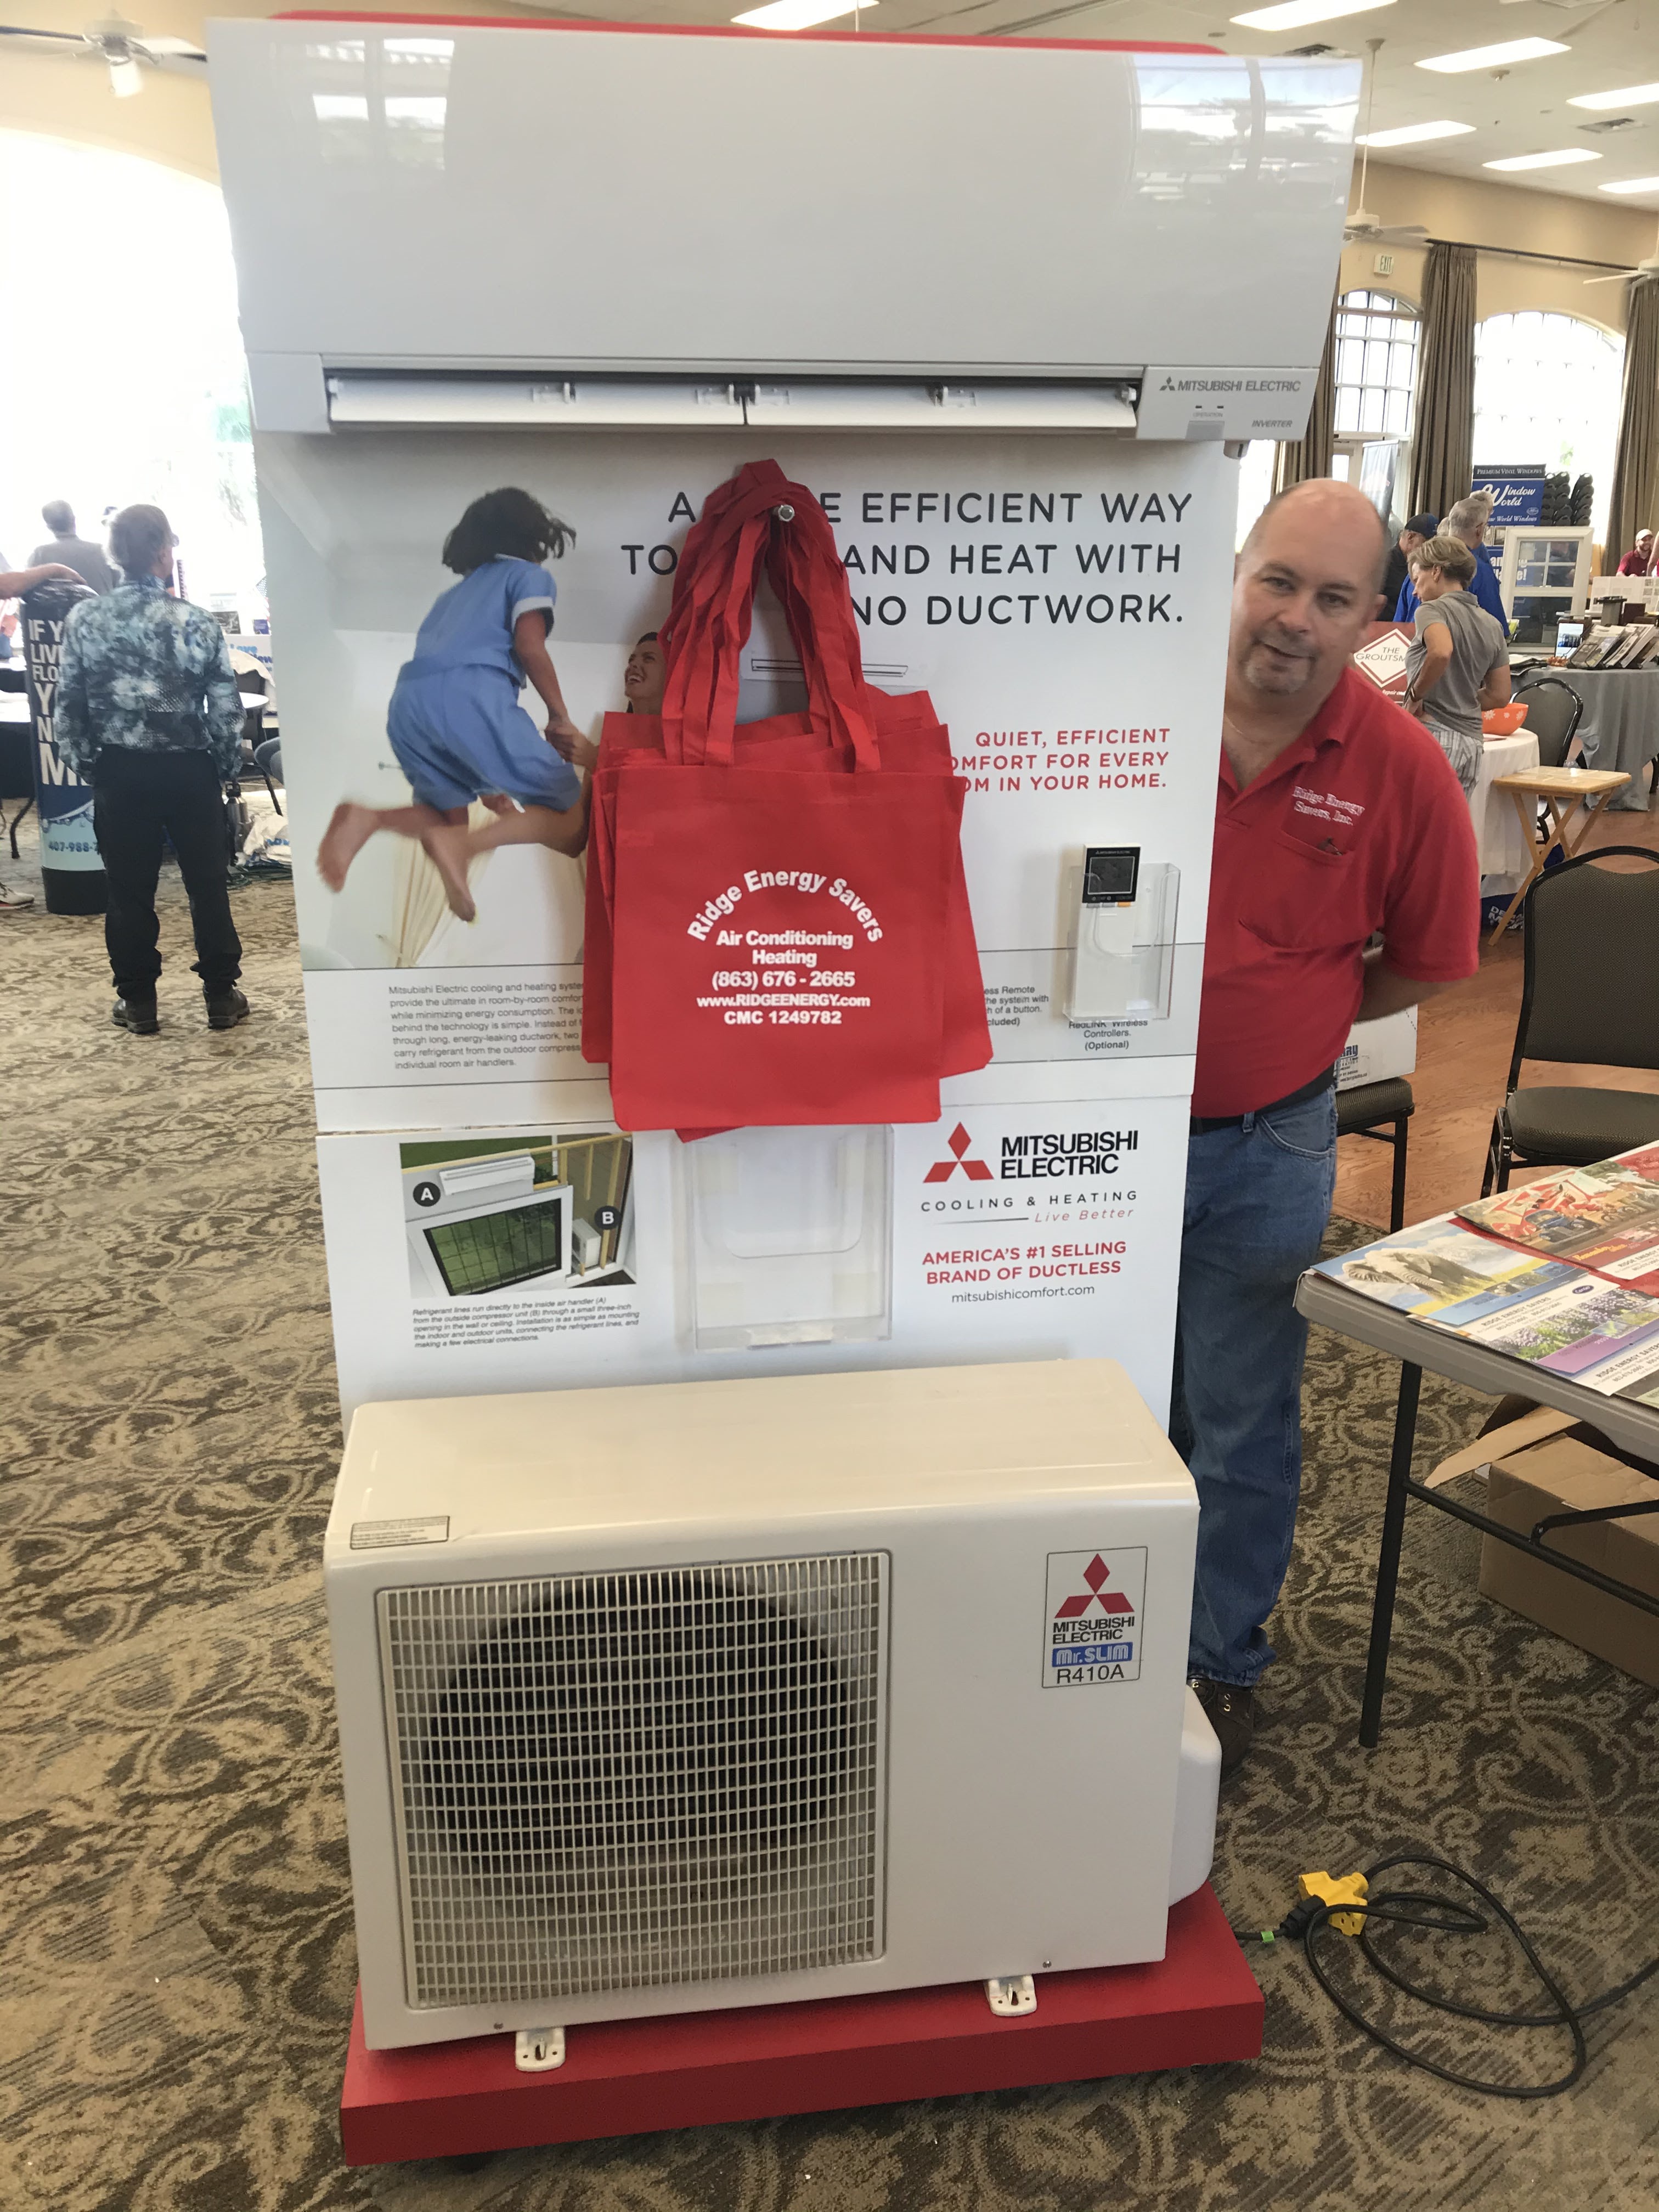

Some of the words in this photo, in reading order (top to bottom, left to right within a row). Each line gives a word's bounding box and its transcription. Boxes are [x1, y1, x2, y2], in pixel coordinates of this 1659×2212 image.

[1380, 256, 1392, 272] EXIT
[1178, 380, 1242, 392] MITSUBISHI
[1245, 381, 1301, 392] ELECTRIC
[668, 492, 696, 523] A
[862, 492, 1082, 523] EFFICIENT
[1101, 492, 1193, 523] WAY
[621, 544, 679, 575] TO
[844, 544, 930, 575] AND
[950, 544, 1057, 574] HEAT
[1076, 543, 1181, 573] WITH
[928, 593, 1183, 625] DUCTWORK.
[28, 619, 46, 641] IF
[1356, 653, 1406, 662] GROUTSM
[976, 731, 1047, 748] QUIET,
[1057, 728, 1170, 745] EFFICIENT
[1047, 753, 1090, 769] FOR
[1099, 751, 1169, 768] EVERY
[1000, 777, 1020, 792] IN
[1030, 775, 1089, 791] YOUR
[1099, 772, 1166, 789] HOME.
[687, 885, 742, 941] Ridge
[744, 870, 827, 893] Energy
[828, 878, 883, 942] Savers
[716, 930, 742, 946] Air
[746, 930, 854, 950] Conditioning
[752, 949, 817, 968] Heating
[471, 984, 503, 993] cooling
[524, 983, 556, 992] heating
[559, 983, 583, 991] syste
[712, 970, 759, 991] (863)
[762, 970, 796, 987] 676
[810, 970, 855, 987] 2665
[1001, 986, 1035, 994] Remote
[390, 999, 424, 1009] provide
[489, 996, 549, 1005] room-by-room
[697, 994, 871, 1007] www.RIDGEENERGY.com
[999, 995, 1030, 1005] system
[1032, 995, 1049, 1003] with
[391, 1011, 413, 1019] while
[416, 1011, 462, 1019] minimizing
[465, 1010, 495, 1019] energy
[498, 1008, 556, 1017] consumption.
[724, 1011, 763, 1025] CMC
[769, 1010, 842, 1024] 1249782
[995, 1006, 1003, 1014] of
[1013, 1005, 1042, 1014] button.
[392, 1024, 422, 1032] behind
[441, 1023, 489, 1031] technology
[501, 1020, 532, 1029] simple.
[988, 1017, 1020, 1028] cluded)
[393, 1036, 427, 1046] through
[453, 1034, 517, 1044] energy-leaking
[1084, 1029, 1131, 1039] Controllers.
[394, 1049, 416, 1058] carry
[419, 1047, 464, 1057] refrigerant
[466, 1047, 485, 1055] from
[487, 1046, 501, 1054] the
[503, 1045, 536, 1053] outdoor
[539, 1045, 582, 1053] compress
[1085, 1040, 1129, 1051] (Optional)
[395, 1060, 437, 1069] individual
[463, 1059, 474, 1068] air
[477, 1058, 516, 1067] handlers.
[1002, 1130, 1138, 1157] MITSUBISHI
[1001, 1153, 1119, 1180] ELECTRIC
[420, 1188, 434, 1201] A
[921, 1198, 1013, 1212] COOLING
[1027, 1196, 1035, 1206] &
[1049, 1190, 1137, 1204] HEATING
[602, 1211, 614, 1224] B
[1035, 1212, 1070, 1223] Live
[1079, 1208, 1134, 1220] Better
[922, 1248, 1020, 1265] AMERICA'S
[1026, 1246, 1045, 1259] #1
[1052, 1241, 1126, 1257] SELLING
[927, 1268, 991, 1284] BRAND
[997, 1266, 1022, 1280] OF
[1029, 1261, 1121, 1278] DUCTLESS
[952, 1285, 1094, 1303] mitsubishicomfort.com
[1053, 1616, 1135, 1633] MITSUBISHI
[1053, 1629, 1124, 1645] ELECTRIC
[1057, 1664, 1125, 1684] R410A
